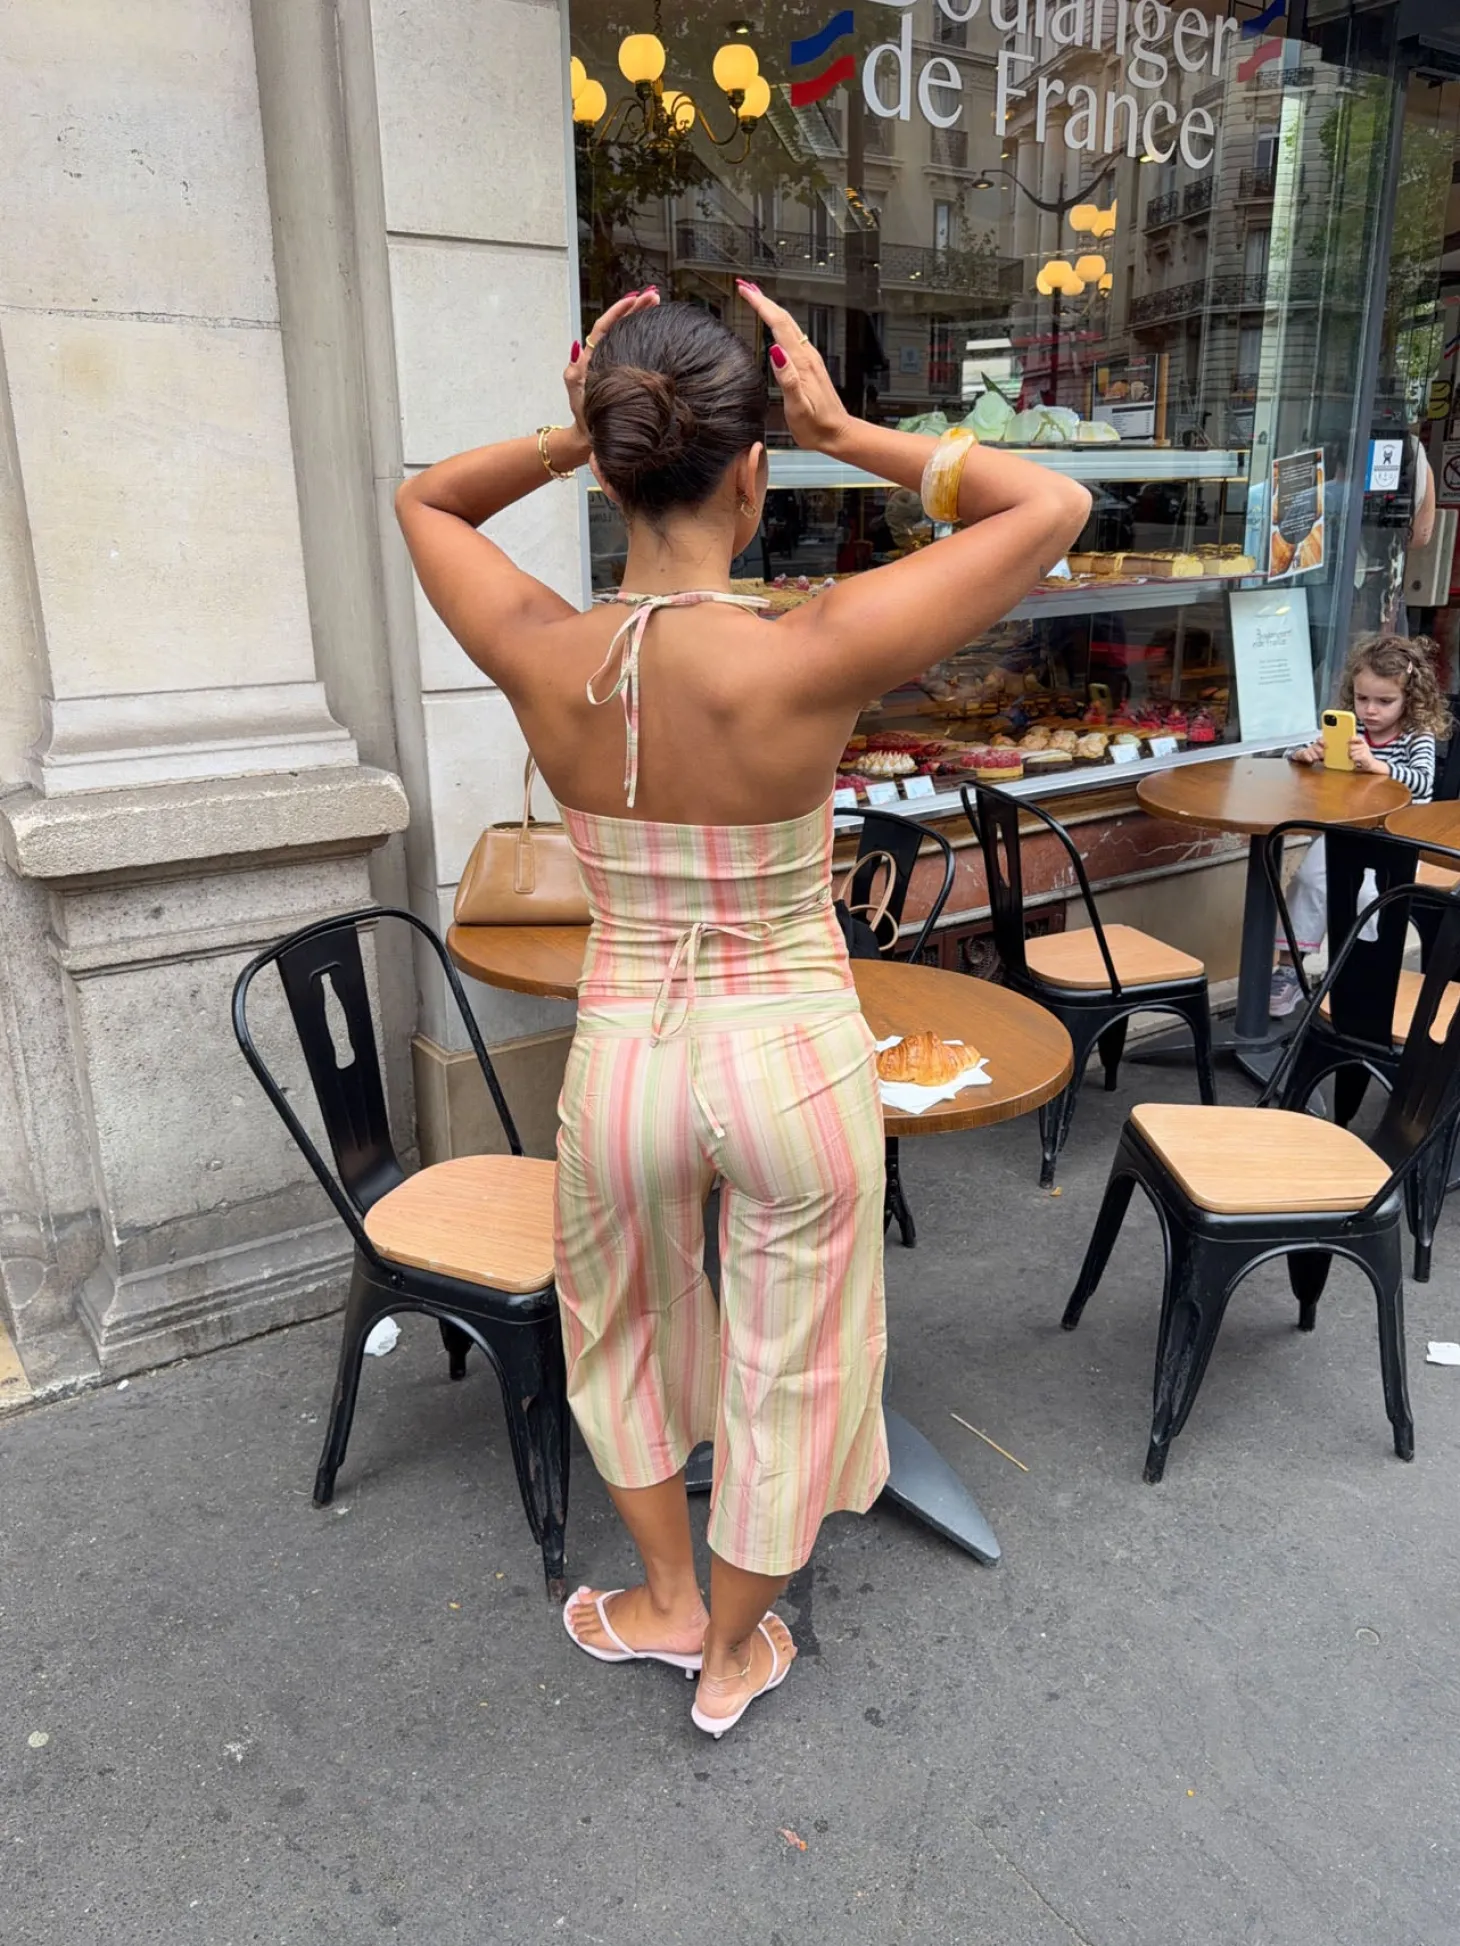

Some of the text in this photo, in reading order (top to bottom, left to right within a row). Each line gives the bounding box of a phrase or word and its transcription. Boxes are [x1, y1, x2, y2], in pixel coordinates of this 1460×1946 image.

[862, 12, 1215, 170] de France
[867, 0, 1238, 89] uanger
